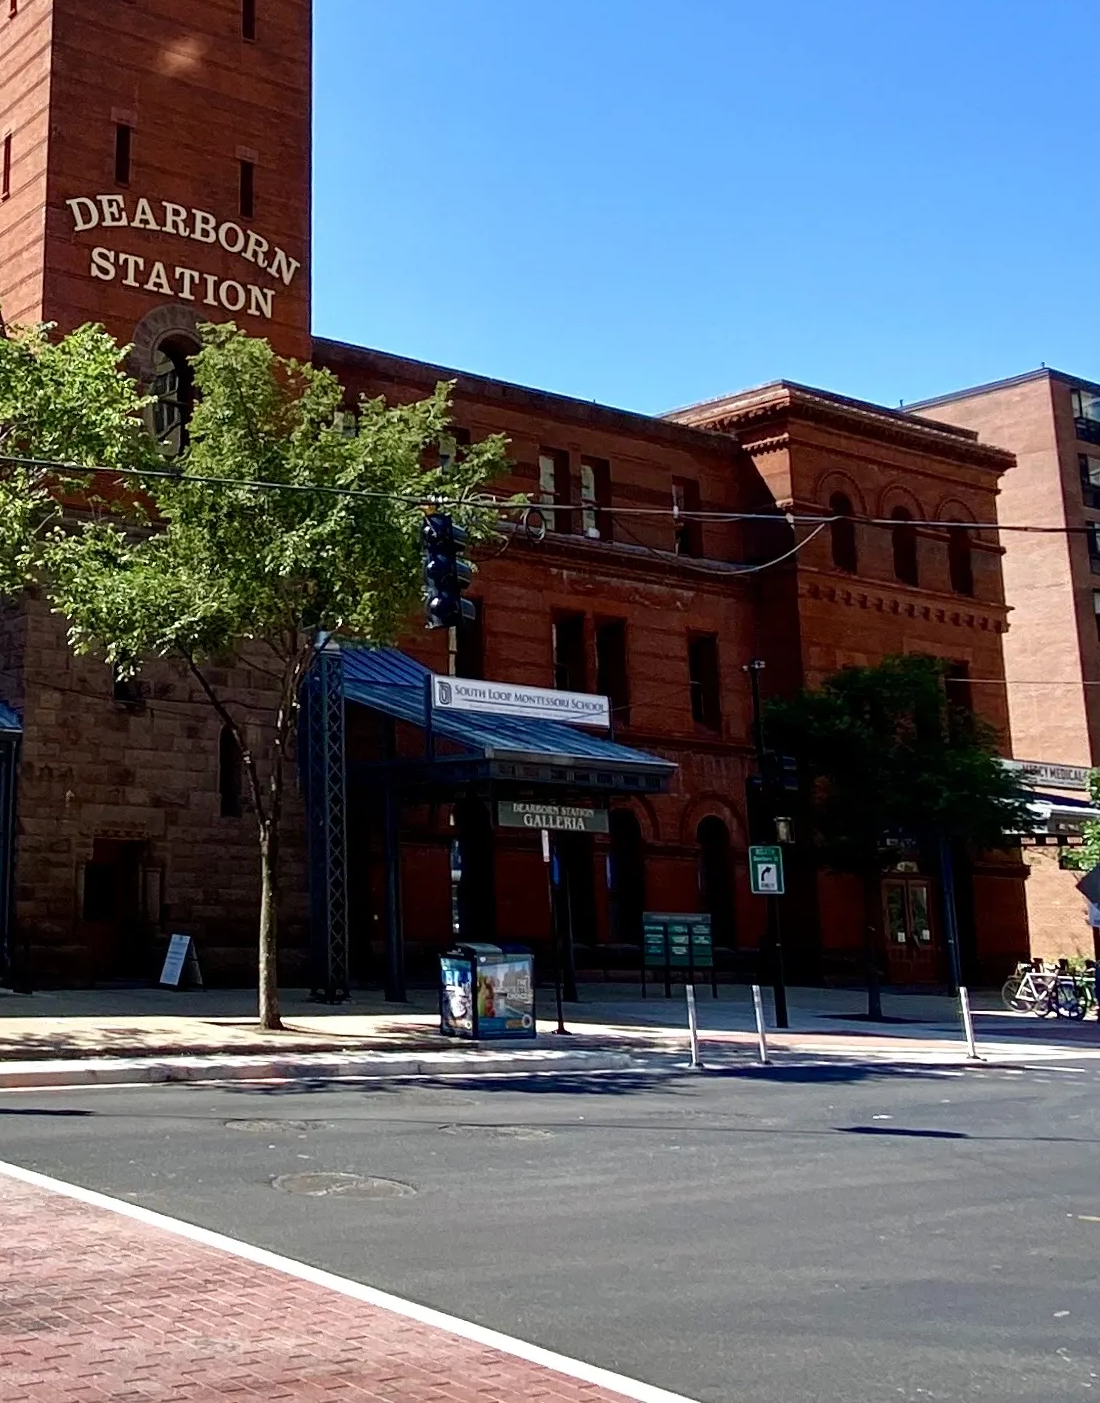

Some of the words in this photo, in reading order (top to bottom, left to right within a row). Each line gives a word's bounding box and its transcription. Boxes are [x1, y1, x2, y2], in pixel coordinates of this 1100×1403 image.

[66, 194, 301, 286] DEARBORN
[90, 247, 276, 320] STATION
[454, 684, 486, 699] SOUTH
[488, 688, 512, 702] LOOP
[513, 803, 558, 815] DEARBORN
[523, 814, 586, 830] GALLERIA
